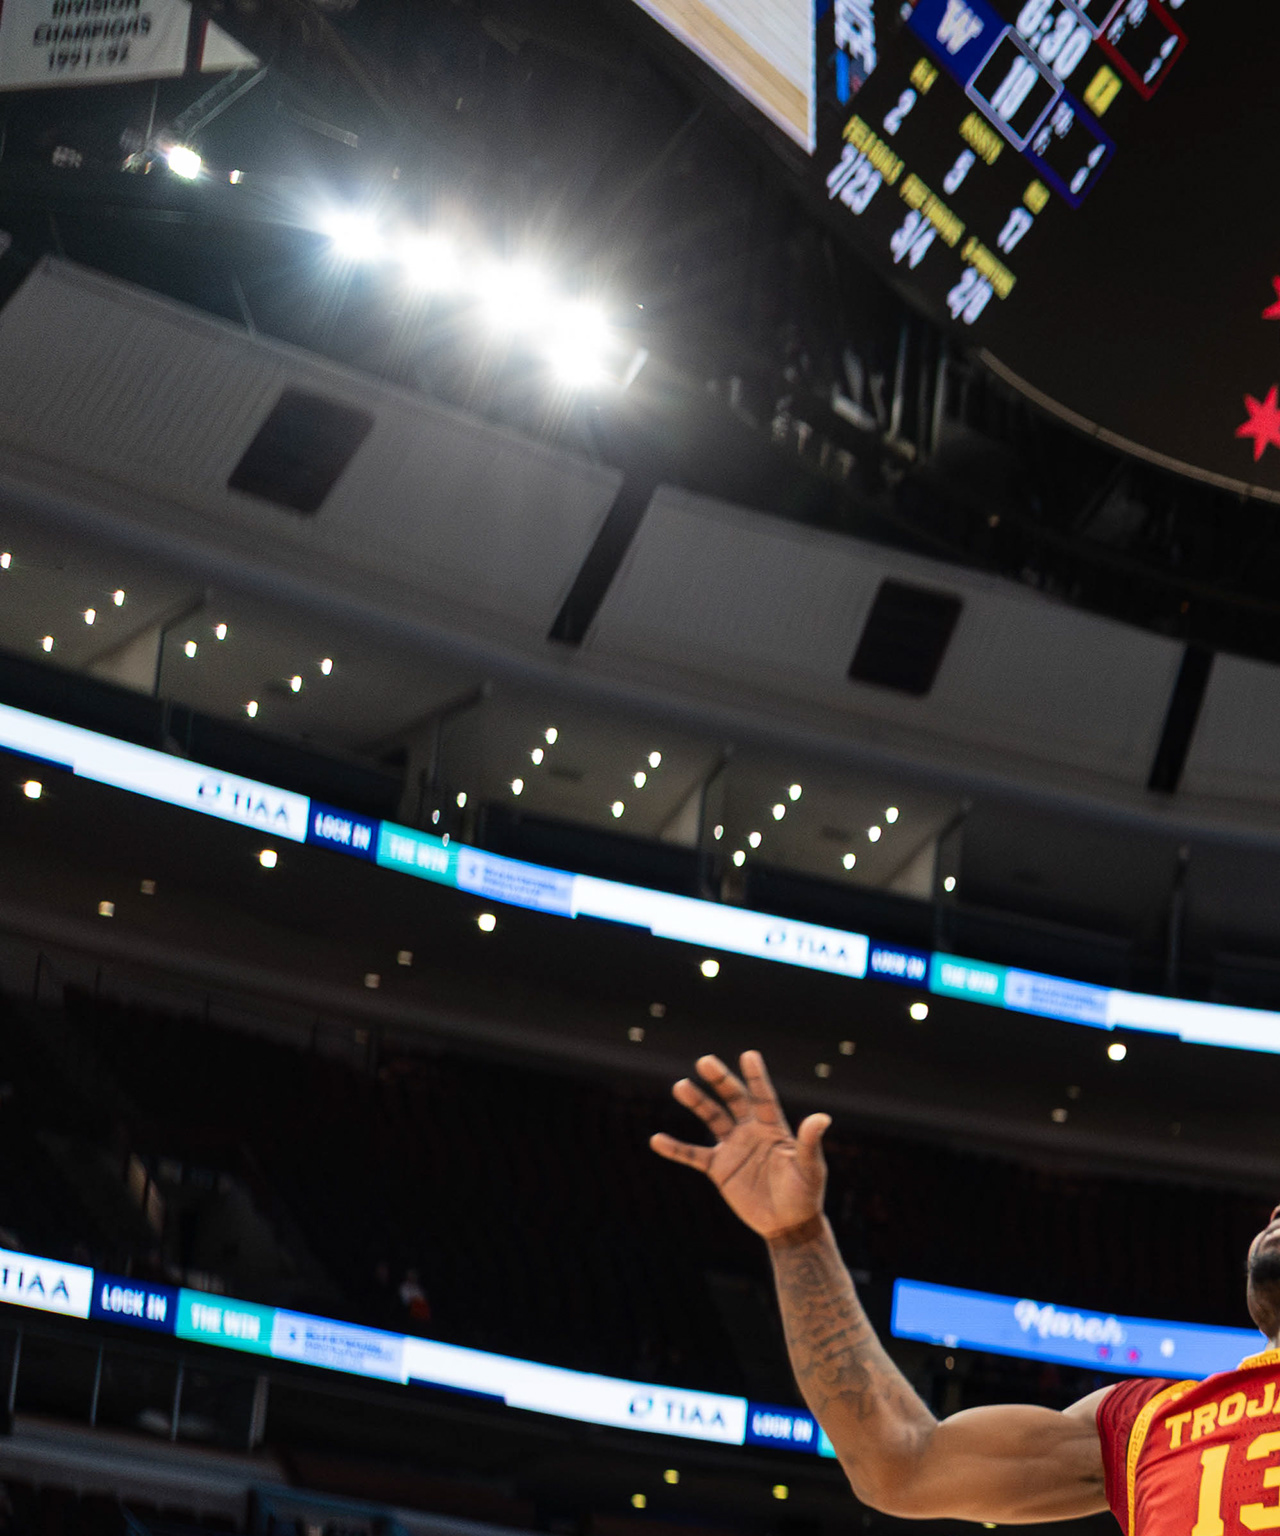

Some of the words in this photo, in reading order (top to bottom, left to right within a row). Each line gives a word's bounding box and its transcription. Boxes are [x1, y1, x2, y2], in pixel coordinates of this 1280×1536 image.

[882, 87, 917, 136] 2
[314, 810, 351, 846] LOCK
[101, 1282, 146, 1319] LOCK
[146, 1293, 168, 1323] IN
[189, 1301, 223, 1334] THE
[222, 1308, 262, 1342] WIN
[664, 1401, 727, 1430] TIAA
[751, 1410, 793, 1441] LOCK
